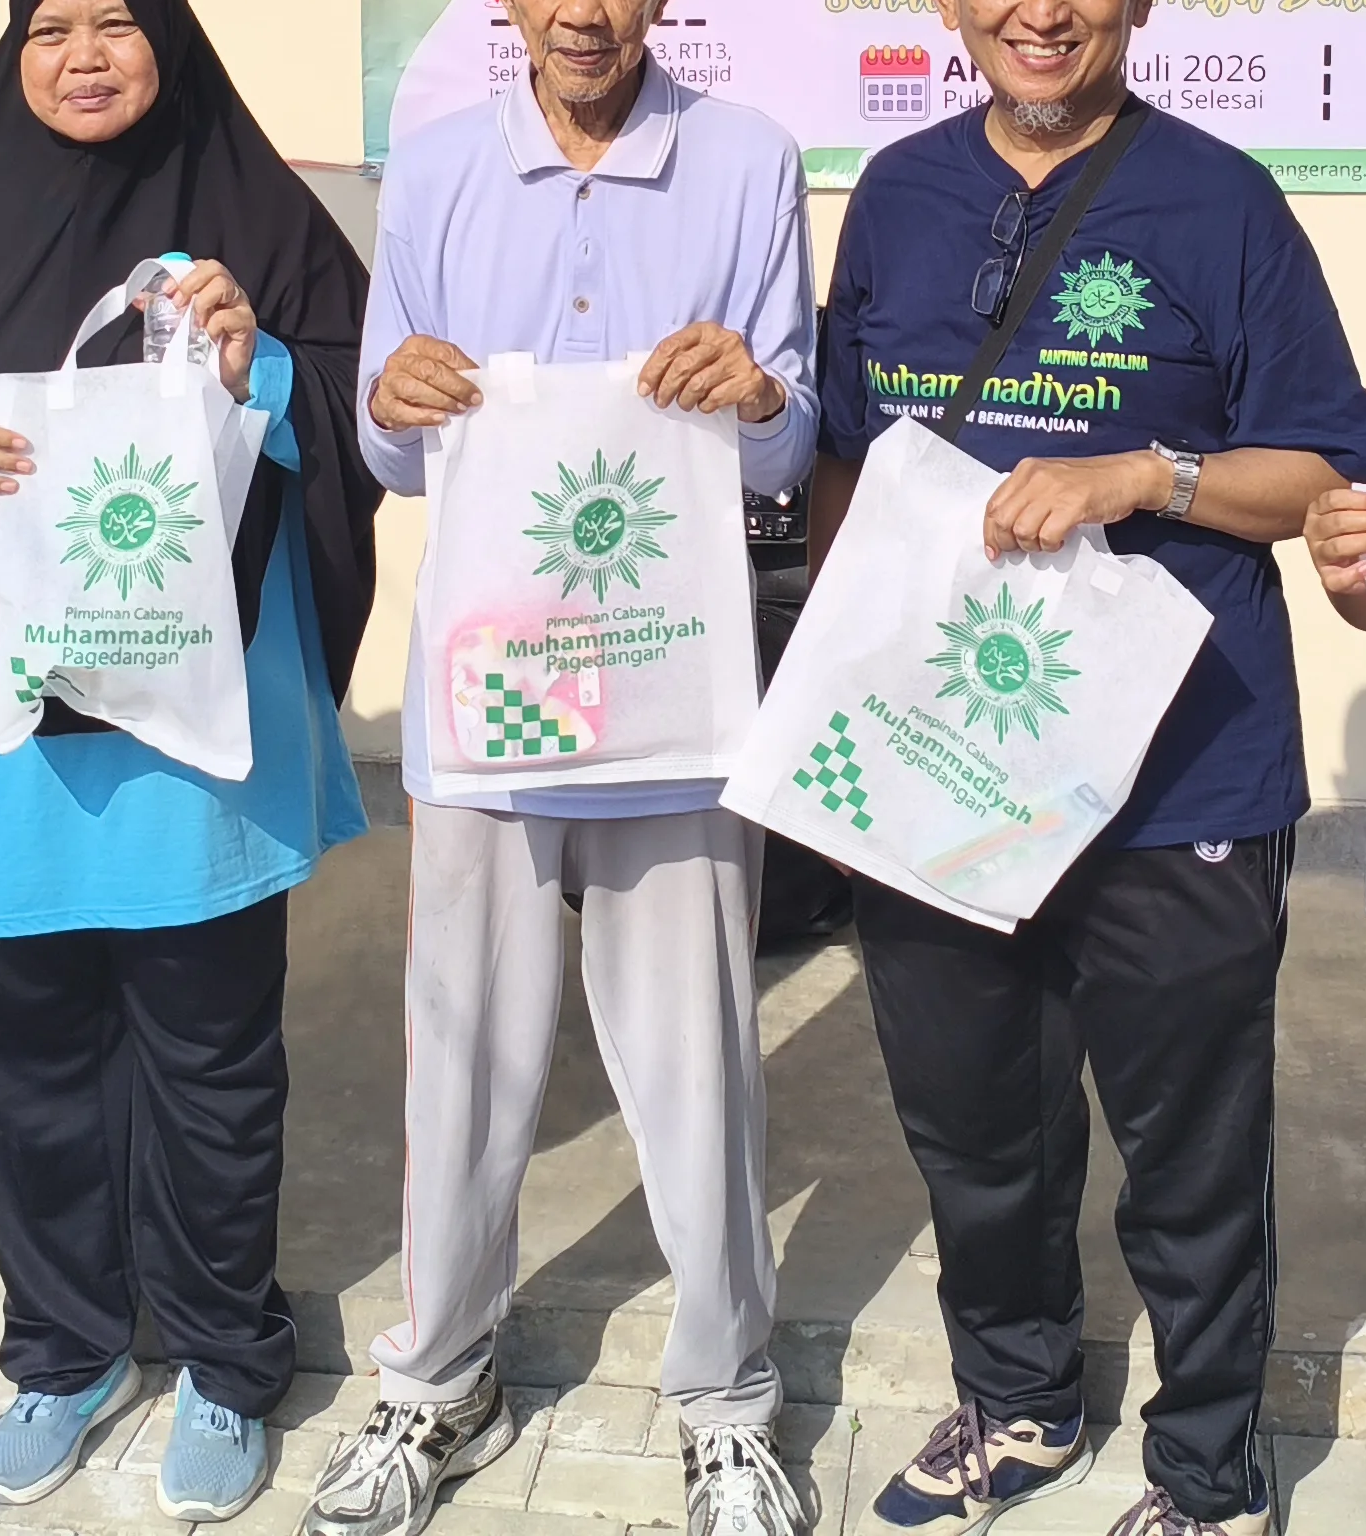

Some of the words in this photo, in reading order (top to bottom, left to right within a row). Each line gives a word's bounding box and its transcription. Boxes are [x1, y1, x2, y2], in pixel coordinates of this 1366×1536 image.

[679, 43, 732, 62] RT13,
[1183, 54, 1266, 83] 2026
[1180, 88, 1263, 110] Selesai
[1039, 348, 1089, 367] RANTING
[1090, 351, 1149, 372] CATALINA
[977, 409, 1090, 434] BERKEMAJUAN
[64, 606, 130, 625] Pimpinan
[134, 606, 184, 623] Cabang
[545, 611, 610, 632] Pimpinan
[612, 604, 666, 625] Cabang
[24, 622, 213, 650] Muhammadiyah
[505, 616, 707, 658] Muhammadiyah
[62, 646, 180, 670] Pagedangan
[545, 645, 667, 675] Pagedangan
[861, 692, 1034, 826] Muhammadiyah
[907, 705, 965, 748] Pimpinan
[965, 740, 1010, 786] Cabang
[886, 732, 988, 820] Pagedangan
